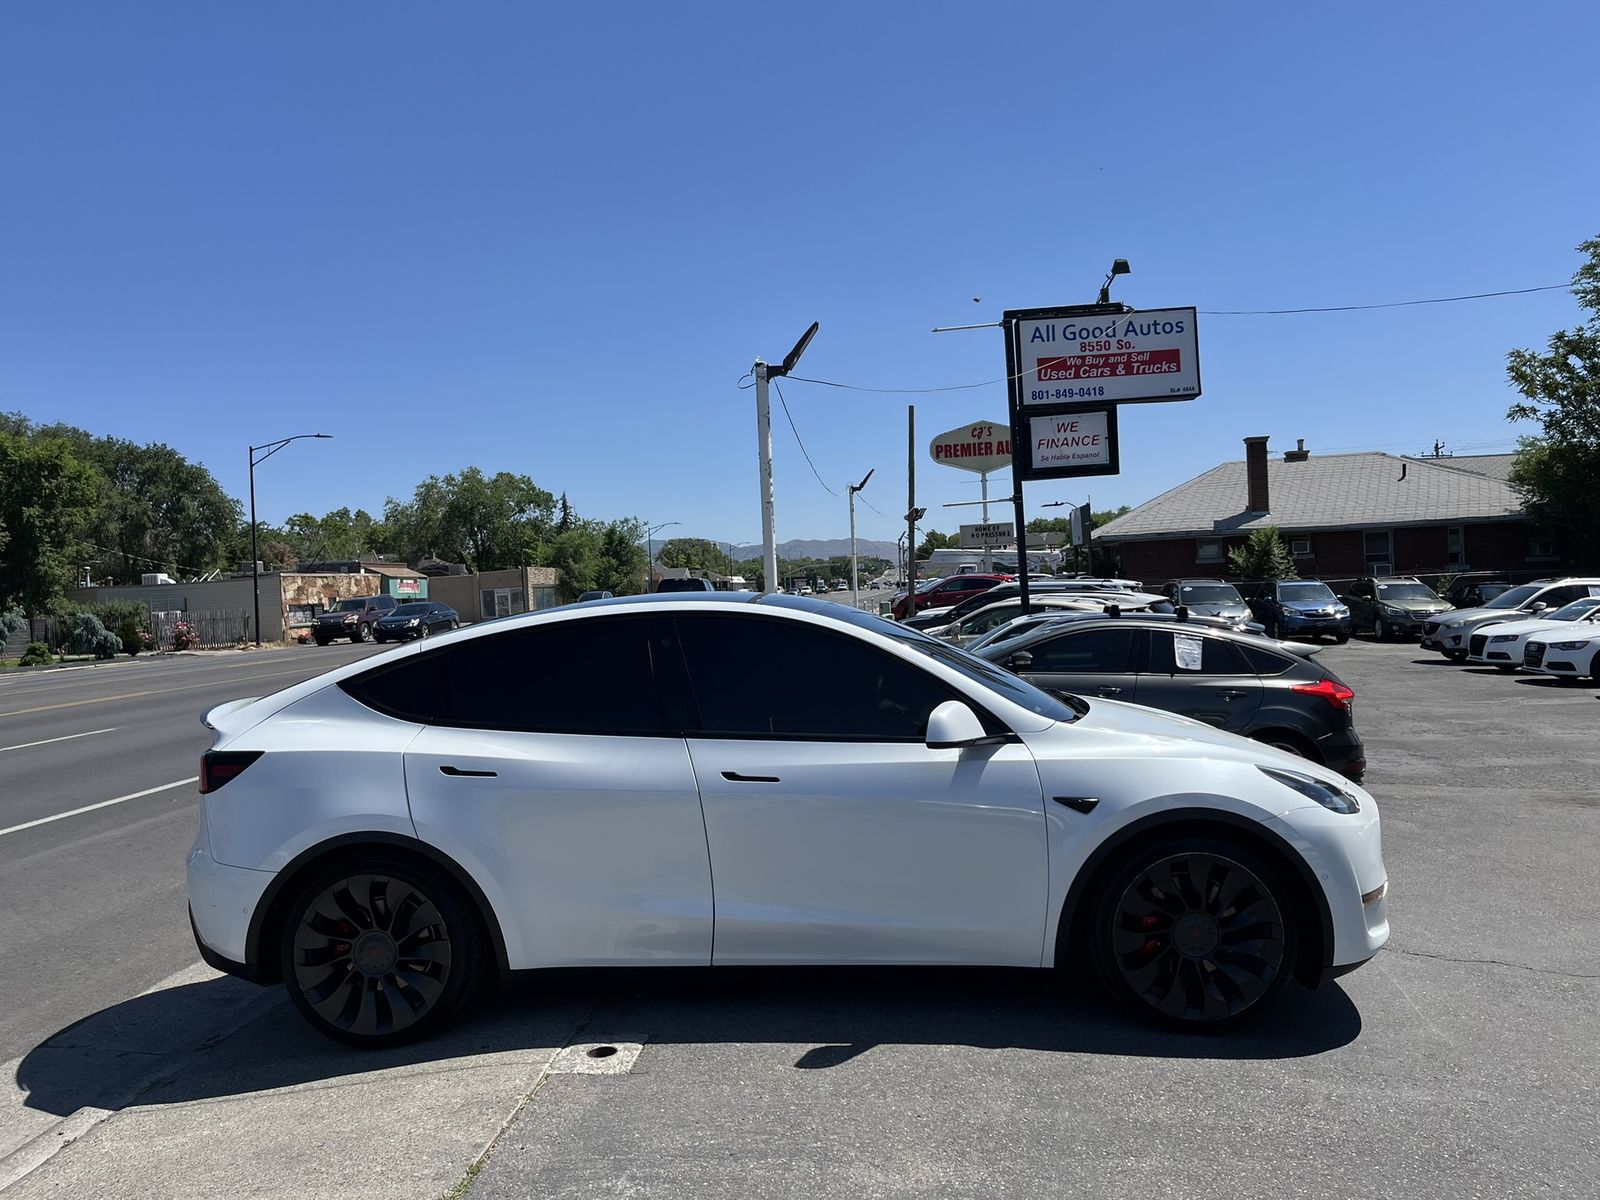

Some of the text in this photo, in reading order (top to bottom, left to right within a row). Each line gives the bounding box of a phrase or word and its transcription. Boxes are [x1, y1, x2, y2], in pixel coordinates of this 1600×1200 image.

[1030, 319, 1185, 344] All Good Autos
[1079, 339, 1136, 353] 8550 So.
[1066, 352, 1150, 367] We Buy and Sell
[1040, 361, 1178, 381] Used Cars & Trucks
[1031, 386, 1105, 401] 801-849-0418
[1056, 421, 1079, 433] WE
[1037, 434, 1101, 450] FINANCE
[935, 441, 993, 459] PREMIER
[1051, 453, 1071, 461] Habla
